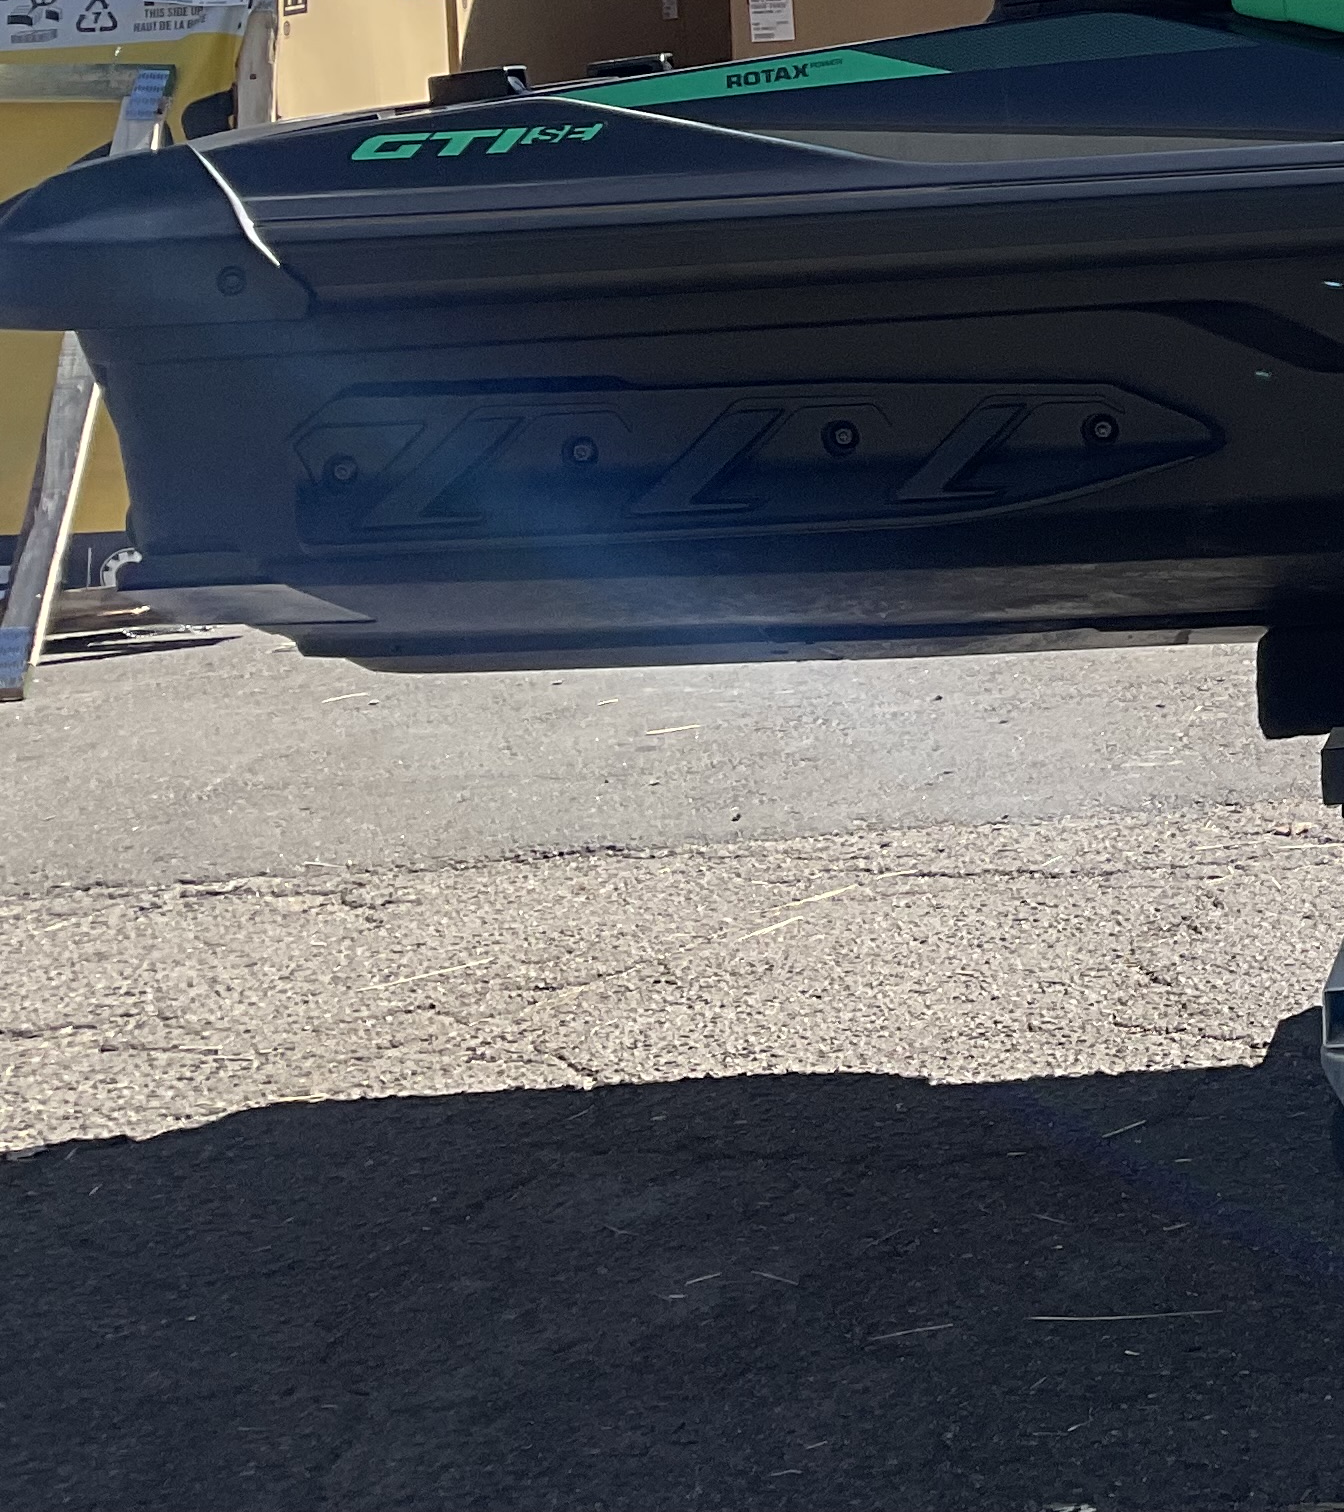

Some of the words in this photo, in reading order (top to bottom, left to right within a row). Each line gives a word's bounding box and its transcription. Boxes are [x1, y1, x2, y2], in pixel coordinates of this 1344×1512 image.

[144, 8, 165, 19] THIS
[167, 7, 188, 18] SIDE
[190, 6, 204, 16] UP
[159, 20, 172, 31] DE
[174, 20, 185, 30] LA
[726, 63, 809, 89] ROTAX
[352, 127, 528, 160] GTI
